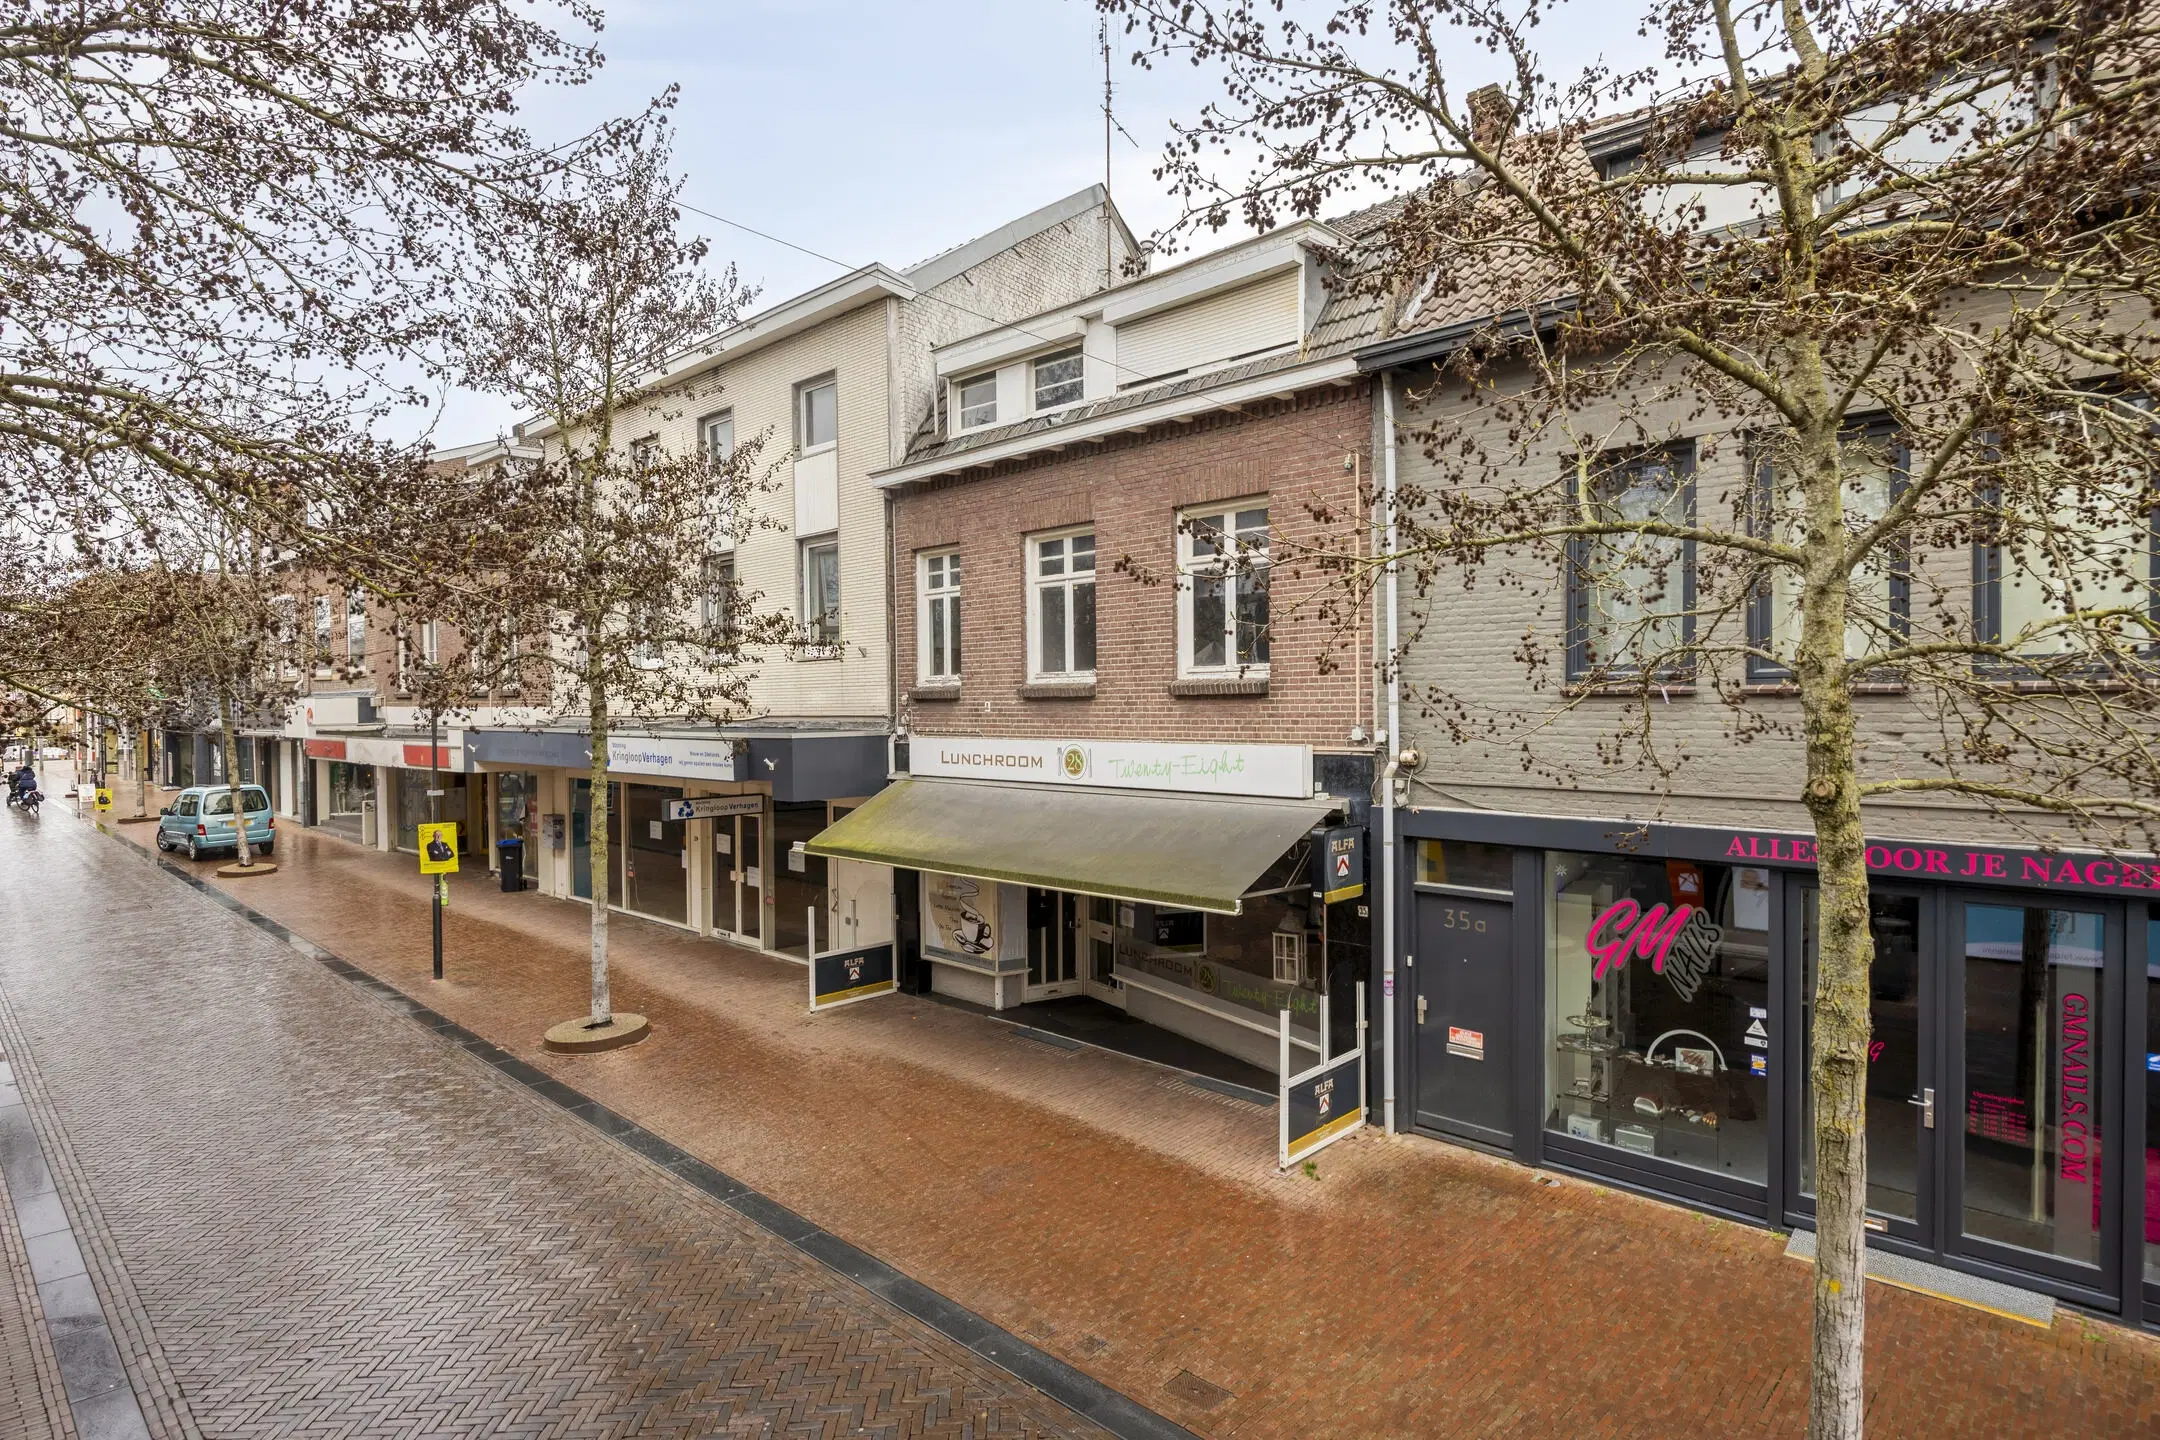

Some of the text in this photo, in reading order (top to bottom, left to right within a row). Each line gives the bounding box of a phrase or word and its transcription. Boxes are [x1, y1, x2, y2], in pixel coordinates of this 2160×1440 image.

[941, 750, 1043, 769] LUNCHROOM
[1067, 751, 1082, 774] 28
[1108, 750, 1245, 784] Twenty-Eight
[696, 802, 759, 813] Kringloop Verhagen
[1331, 837, 1354, 852] ALFA
[1725, 836, 1818, 863] ALLE
[1864, 846, 1952, 874] OOR
[1960, 852, 2007, 878] JE
[1443, 908, 1486, 933] 35a
[1586, 898, 1692, 980] GM
[844, 957, 865, 968] ALFA
[1666, 910, 1720, 1001] NAILS
[1314, 1078, 1334, 1096] ALFA
[2062, 993, 2089, 1184] GMNAILS.COM
